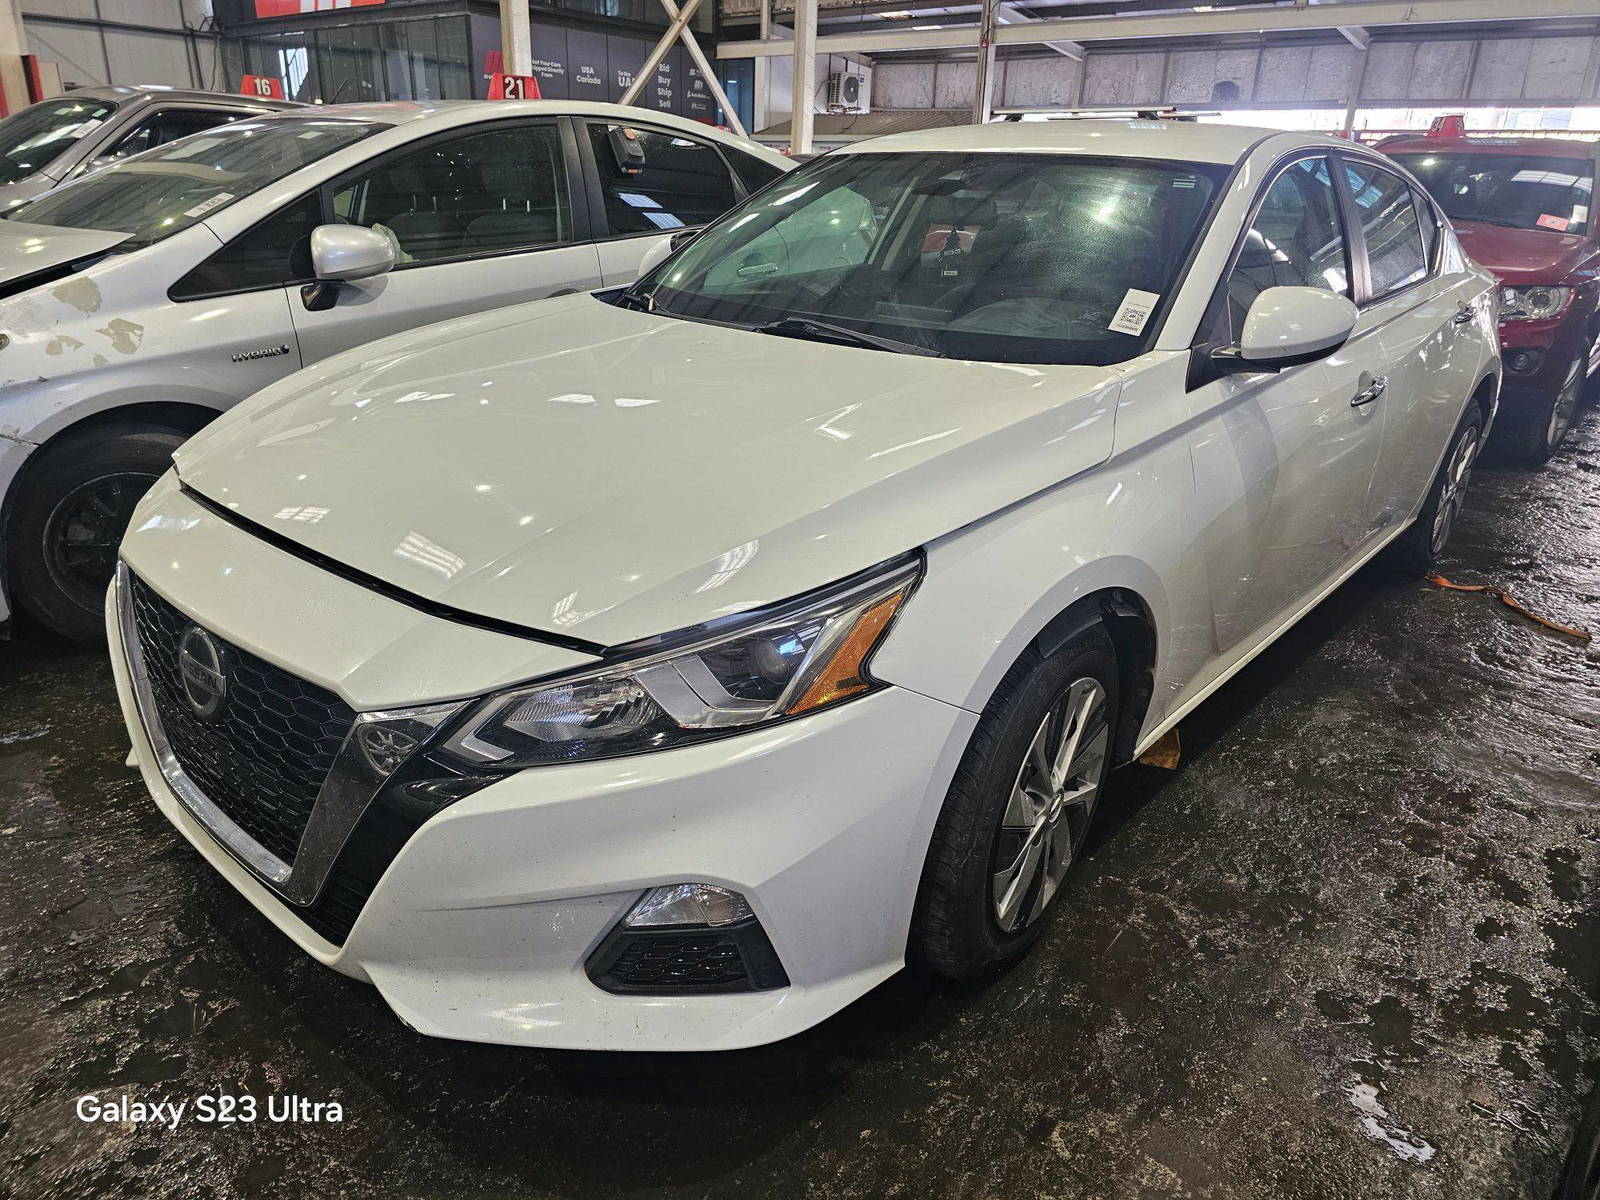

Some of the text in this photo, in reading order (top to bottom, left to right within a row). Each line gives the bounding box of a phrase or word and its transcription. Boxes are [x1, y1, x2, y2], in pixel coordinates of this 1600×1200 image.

[547, 67, 565, 75] Directly
[582, 66, 594, 74] USA
[660, 64, 670, 72] Bid
[577, 76, 601, 85] Canada
[658, 76, 671, 87] Buy
[254, 78, 272, 96] 16
[505, 77, 524, 99] 21
[658, 88, 672, 98] Ship
[659, 100, 671, 108] Sell
[231, 347, 281, 363] HYBRID
